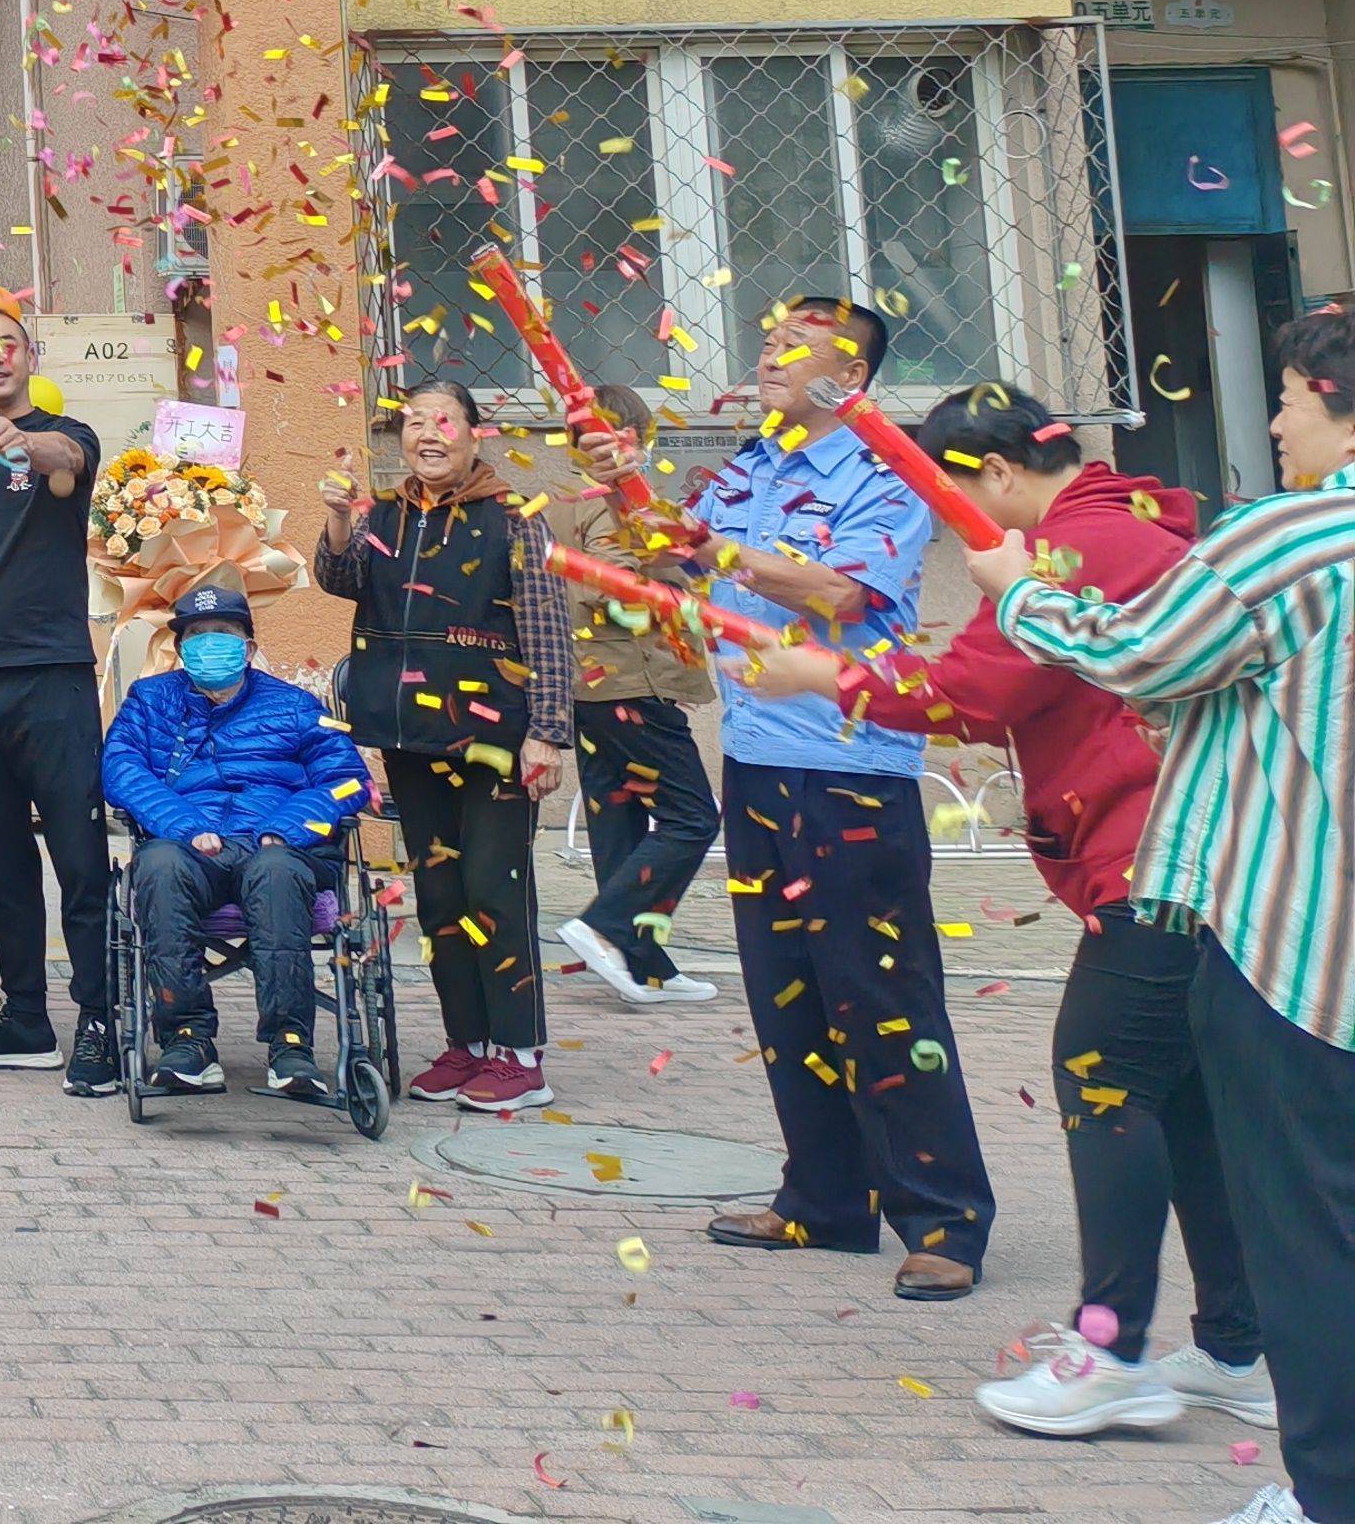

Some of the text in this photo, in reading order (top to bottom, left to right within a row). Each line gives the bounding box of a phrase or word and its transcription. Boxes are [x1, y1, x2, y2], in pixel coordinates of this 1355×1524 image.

[84, 341, 129, 360] A02
[164, 416, 235, 443] 开工大吉
